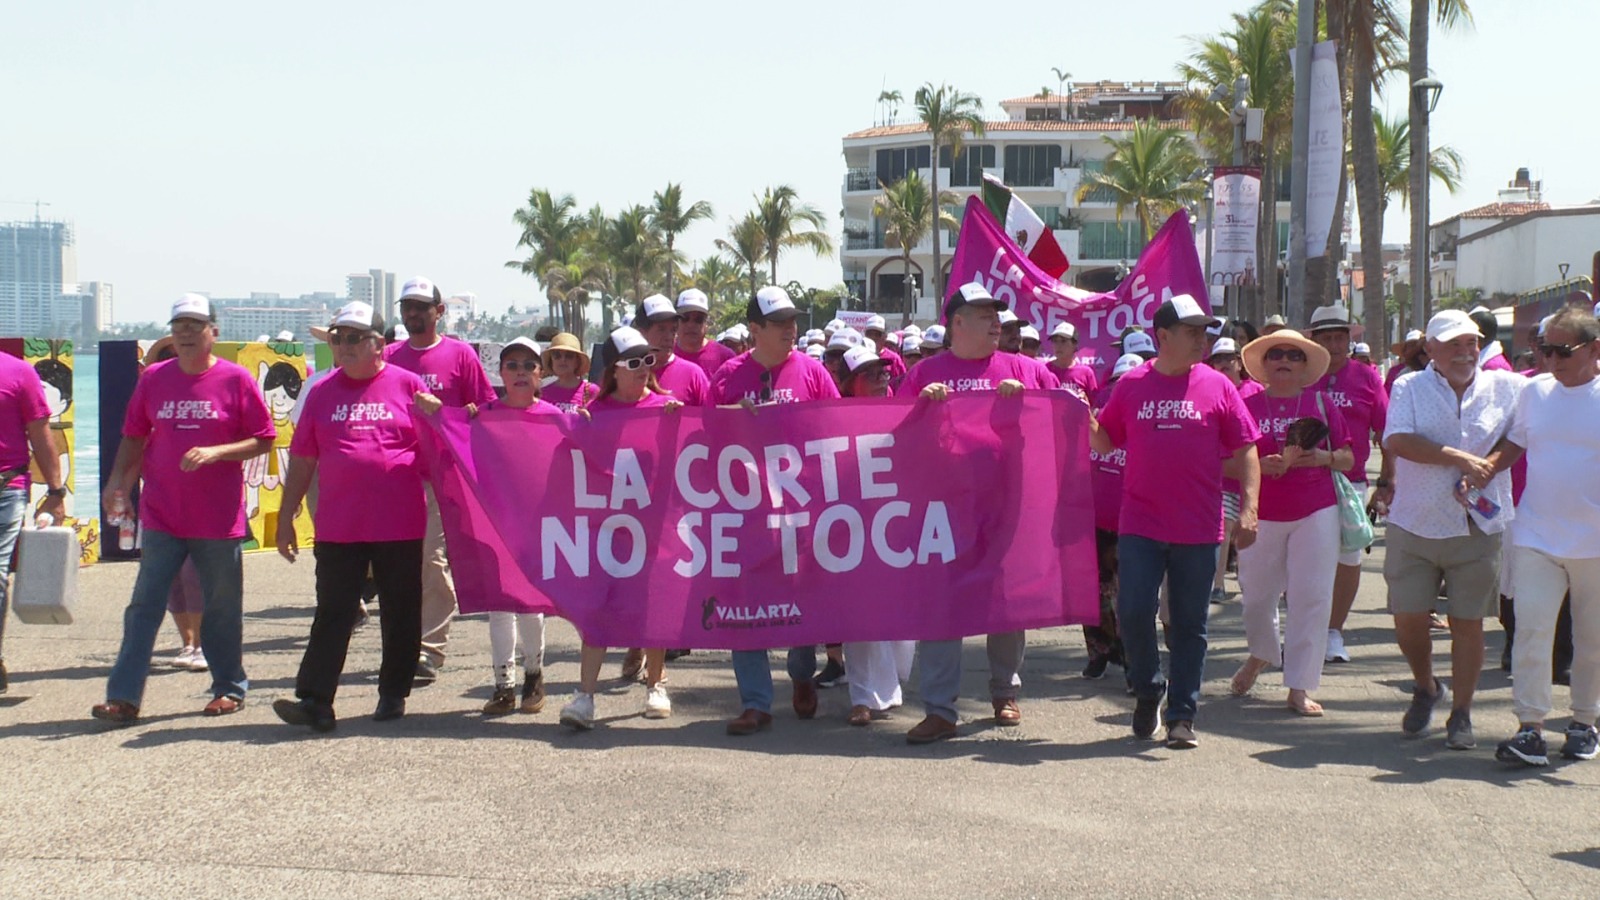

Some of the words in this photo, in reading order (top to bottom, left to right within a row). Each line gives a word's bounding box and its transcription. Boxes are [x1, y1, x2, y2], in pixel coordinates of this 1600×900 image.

[990, 246, 1025, 289] LA
[957, 378, 991, 388] CORTE
[163, 400, 175, 410] LA
[177, 400, 212, 411] CORTE
[336, 404, 348, 413] LA
[351, 403, 385, 412] CORTE
[1143, 400, 1155, 410] LA
[1158, 400, 1194, 410] CORTE
[1333, 399, 1353, 407] OCA
[156, 410, 173, 420] NO
[175, 410, 188, 419] SE
[191, 410, 219, 420] TOCA
[331, 413, 347, 422] NO
[349, 412, 362, 421] SE
[365, 410, 394, 421] TOCA
[1137, 410, 1153, 420] NO
[1156, 410, 1168, 419] SE
[1173, 410, 1202, 420] TOCA
[1259, 418, 1270, 427] LA
[570, 447, 651, 510] LA
[674, 433, 898, 511] CORTE
[541, 513, 647, 580] NO
[673, 511, 744, 578] SE
[767, 500, 956, 575] TOCA
[716, 602, 802, 620] VALLARTA
